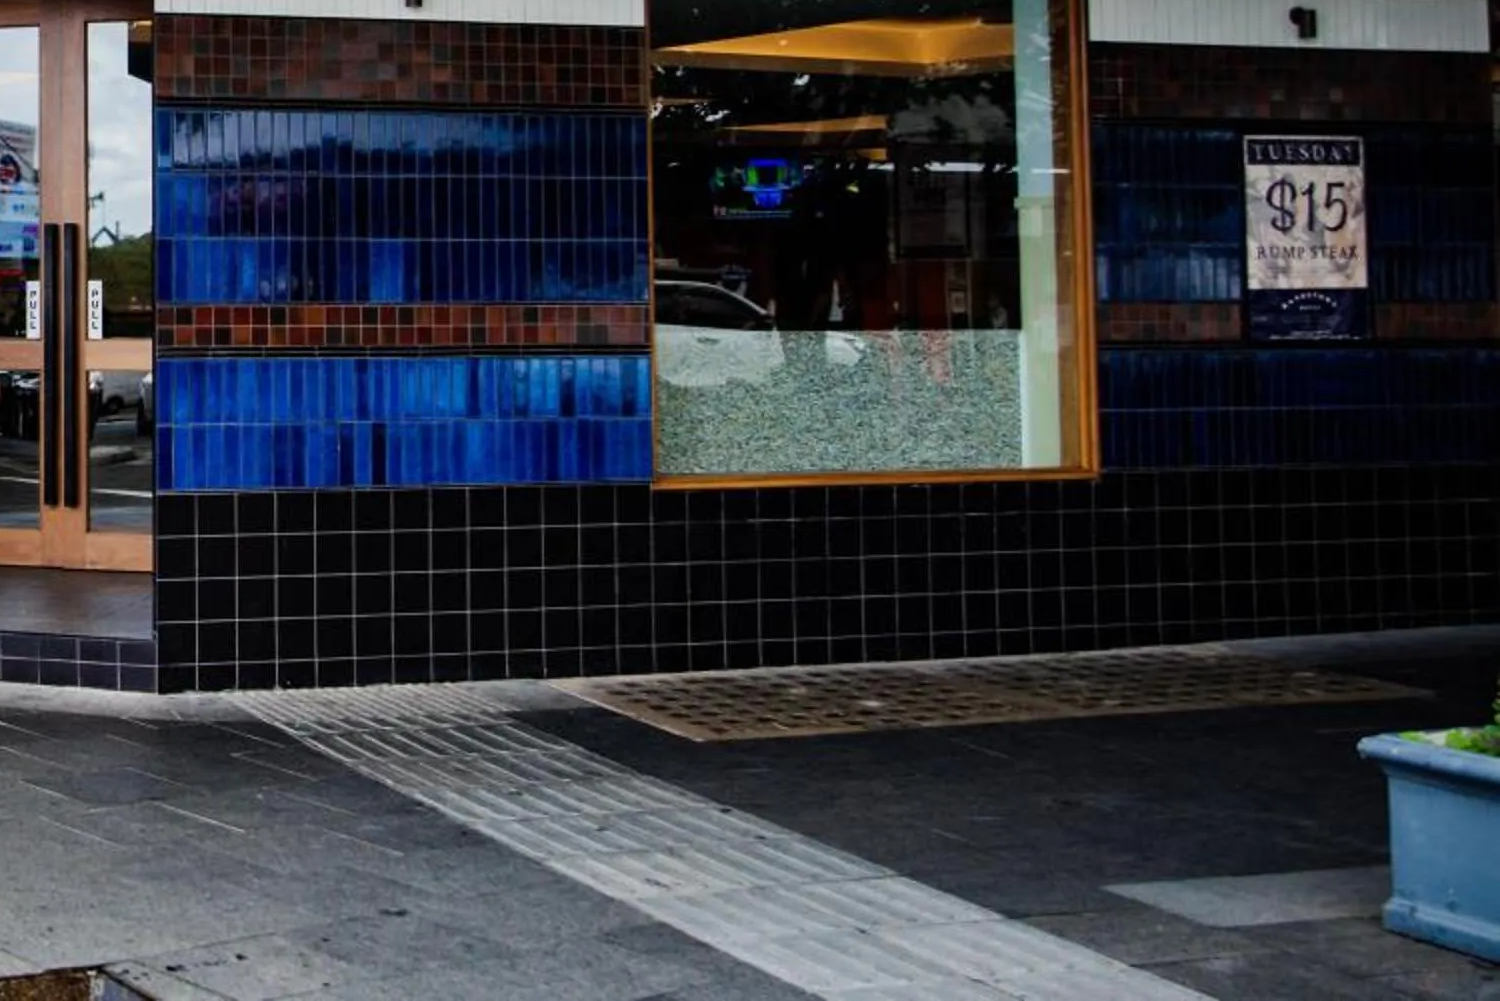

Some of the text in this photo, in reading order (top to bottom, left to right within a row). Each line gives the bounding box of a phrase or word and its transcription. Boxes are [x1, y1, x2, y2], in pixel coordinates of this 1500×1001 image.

[1252, 142, 1356, 162] TUESDAY
[1264, 175, 1348, 235] $15
[1256, 244, 1360, 261] RUMP STEAK
[91, 288, 99, 330] PULL
